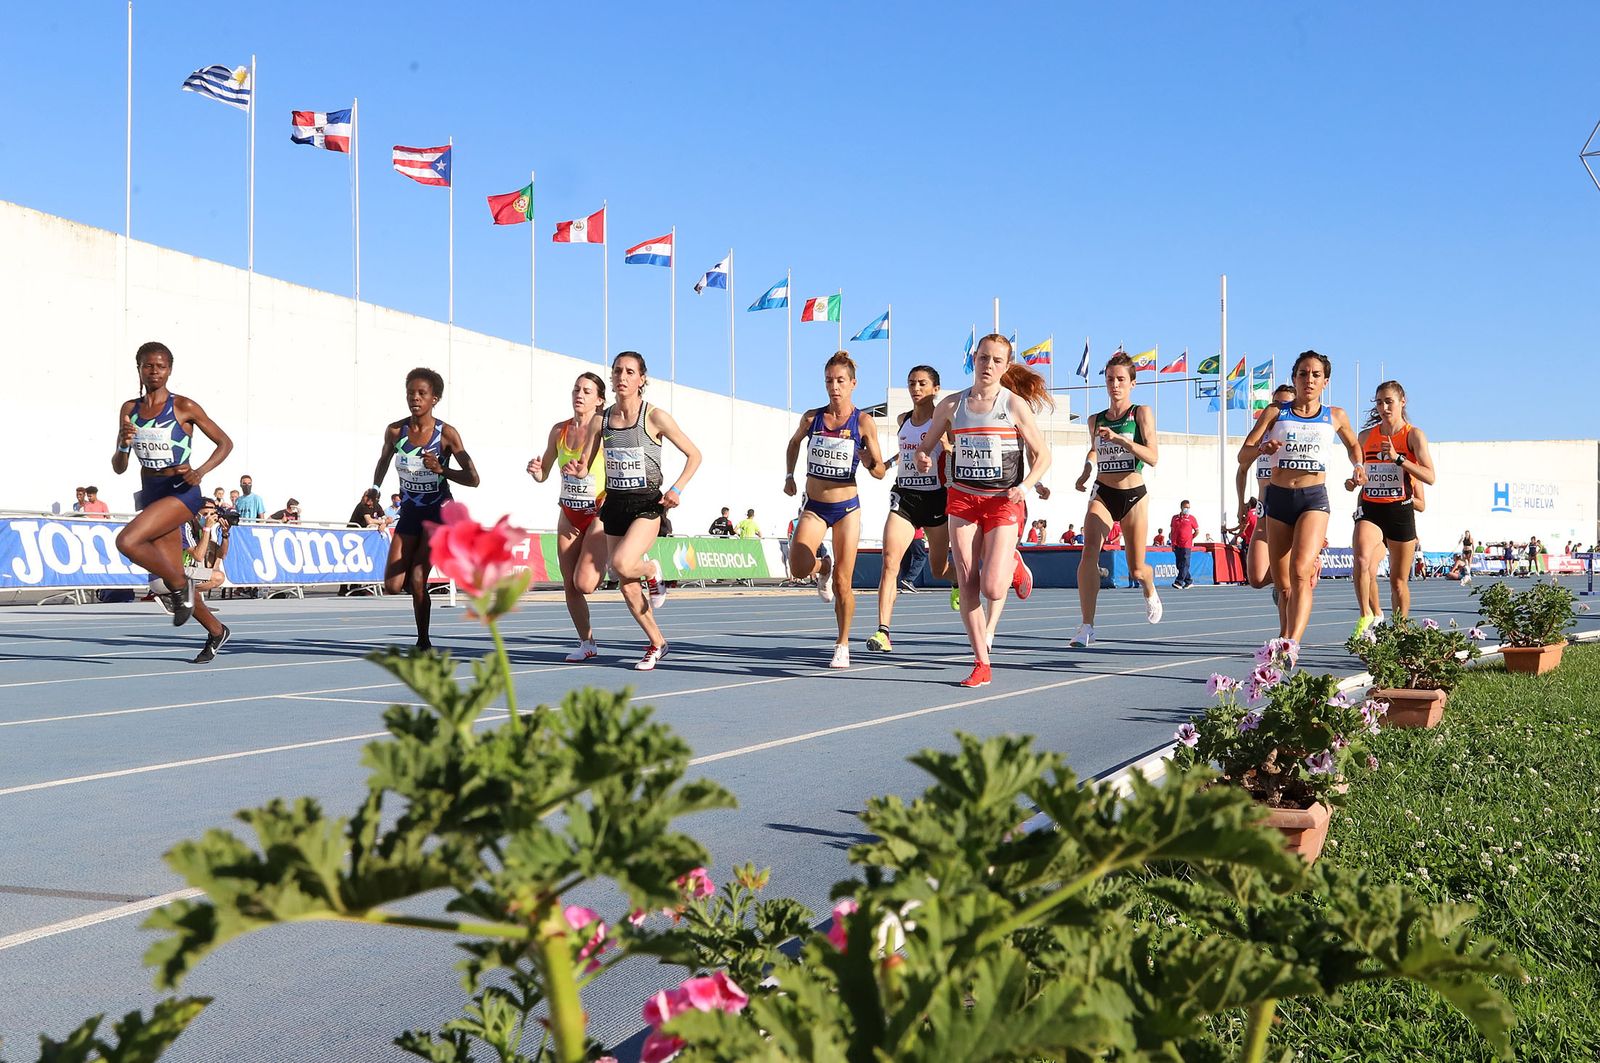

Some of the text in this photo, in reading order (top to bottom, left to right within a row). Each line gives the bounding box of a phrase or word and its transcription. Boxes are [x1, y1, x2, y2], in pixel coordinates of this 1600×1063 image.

[135, 442, 169, 451] ERONO
[1285, 443, 1320, 454] CAMPO
[811, 448, 848, 460] ROBLES
[961, 449, 992, 459] PRATT
[606, 460, 641, 470] BETICHE
[810, 464, 846, 477] Joma
[904, 463, 917, 471] KA
[957, 467, 996, 478] Joma
[1368, 474, 1399, 482] VICIOSA
[900, 477, 933, 486] Joma
[1524, 497, 1554, 509] HUELVA
[10, 520, 149, 584] Jom
[252, 528, 373, 581] Joma
[696, 551, 758, 569] IBERDROLA
